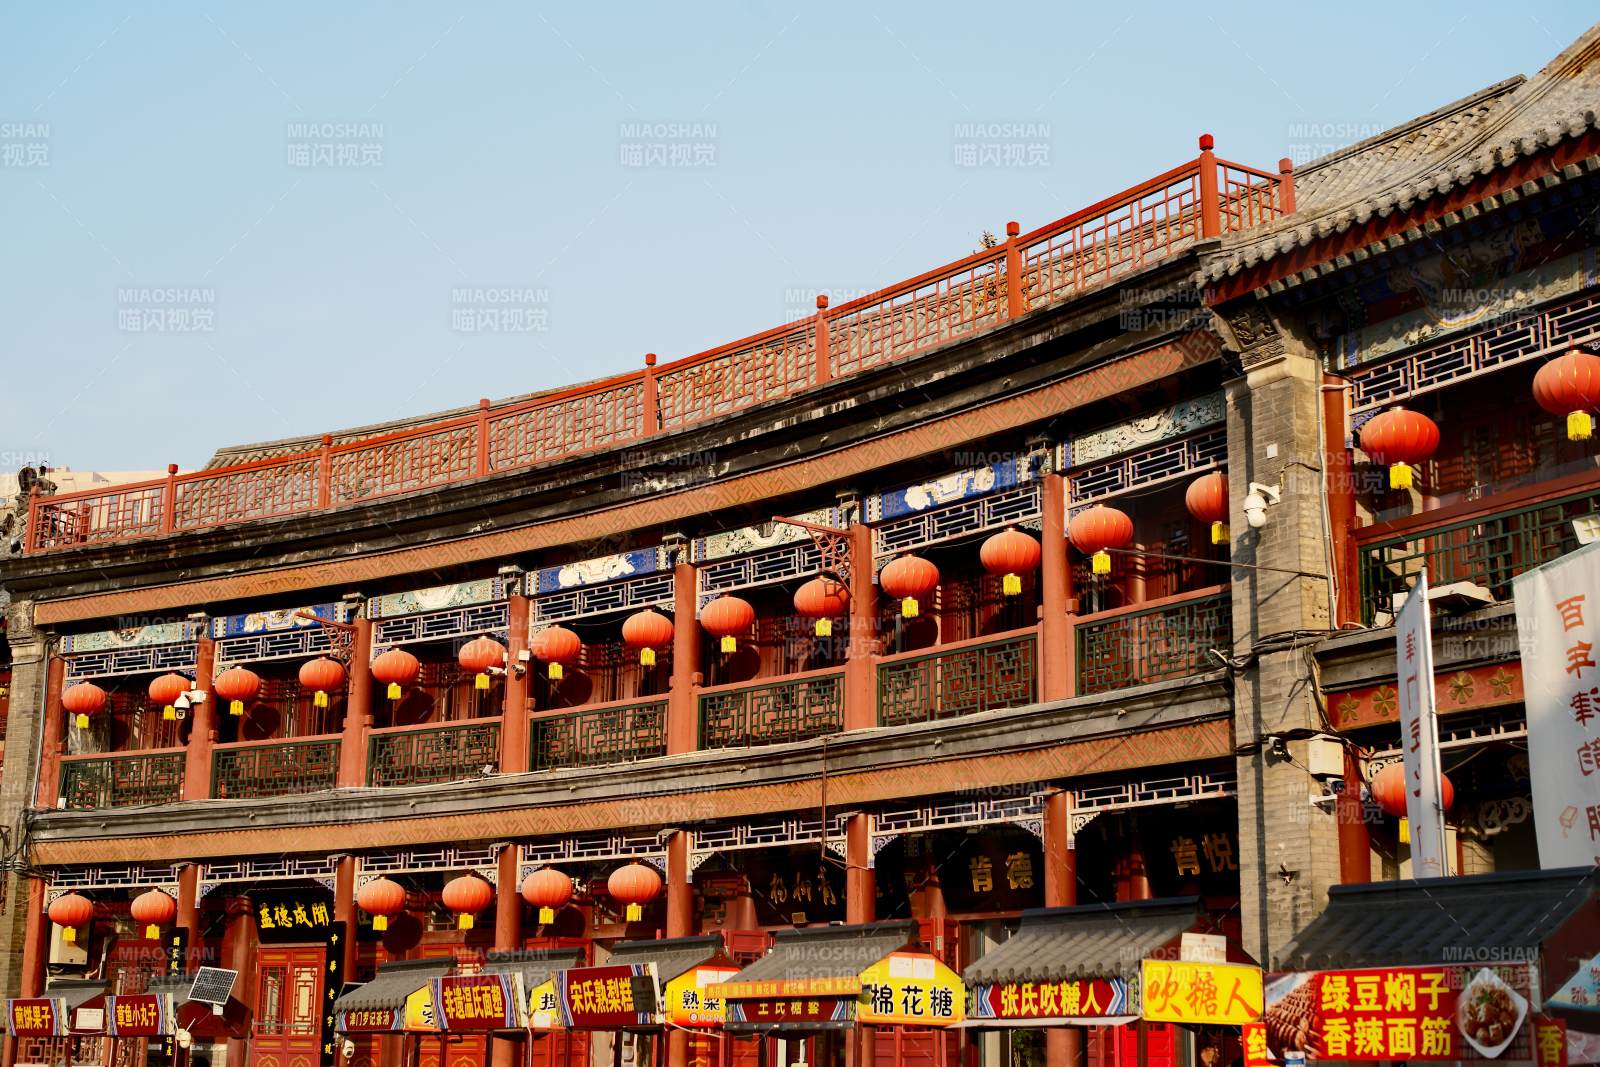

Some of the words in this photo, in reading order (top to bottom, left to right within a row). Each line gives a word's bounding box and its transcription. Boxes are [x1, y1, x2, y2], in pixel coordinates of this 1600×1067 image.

[968, 851, 1034, 893] 肯德
[444, 985, 504, 1019] 非遗温氏面塑
[871, 983, 953, 1018] 棉花糖
[1001, 980, 1102, 1016] 张氏吹糖人
[1147, 964, 1260, 1018] 吹糖人
[1321, 972, 1450, 1013] 绿豆焖子
[14, 1005, 51, 1030] 煎饼果子
[116, 1003, 157, 1028] 章鱼小丸子
[1322, 1016, 1451, 1057] 香辣面筋
[1537, 1024, 1563, 1064] 香
